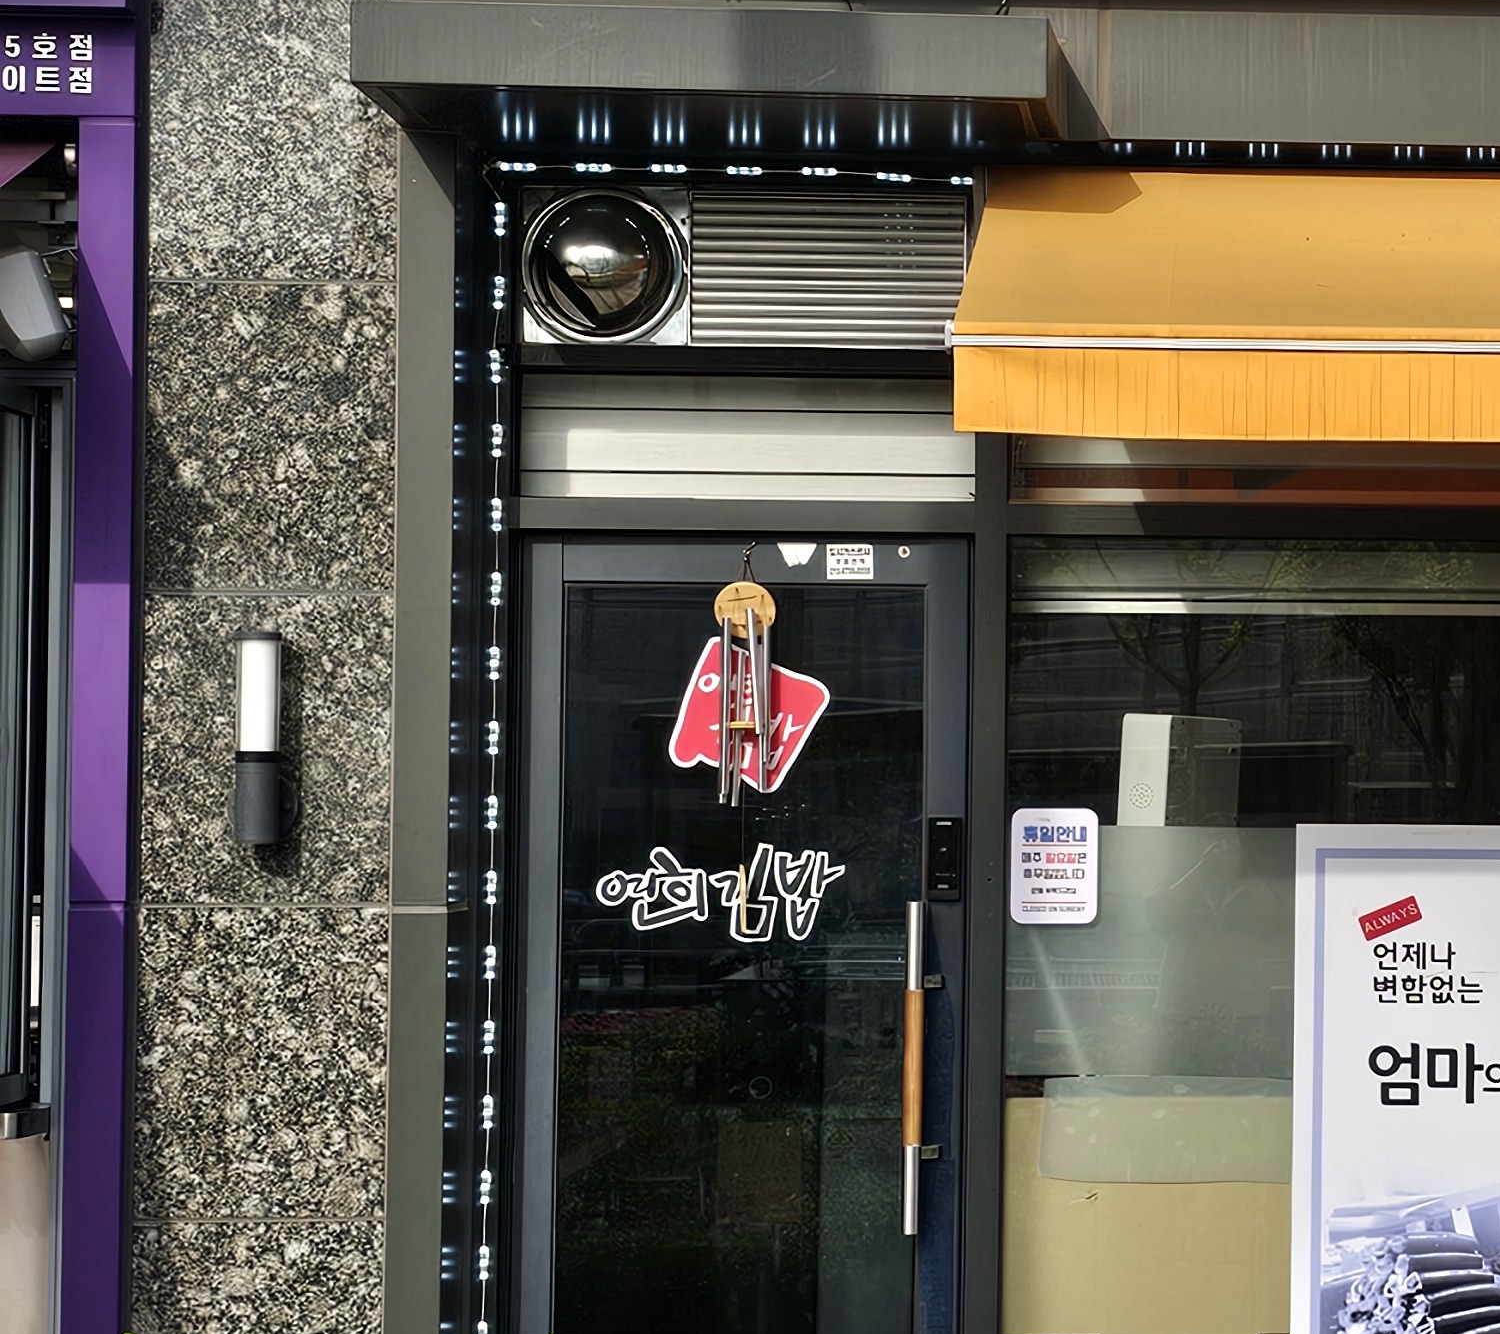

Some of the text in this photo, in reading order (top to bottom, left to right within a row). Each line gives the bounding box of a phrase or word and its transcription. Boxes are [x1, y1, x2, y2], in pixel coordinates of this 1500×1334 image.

[1365, 903, 1418, 933] ALWAYS
[1373, 941, 1456, 971] 언제나
[1373, 973, 1483, 1004] 변함없는
